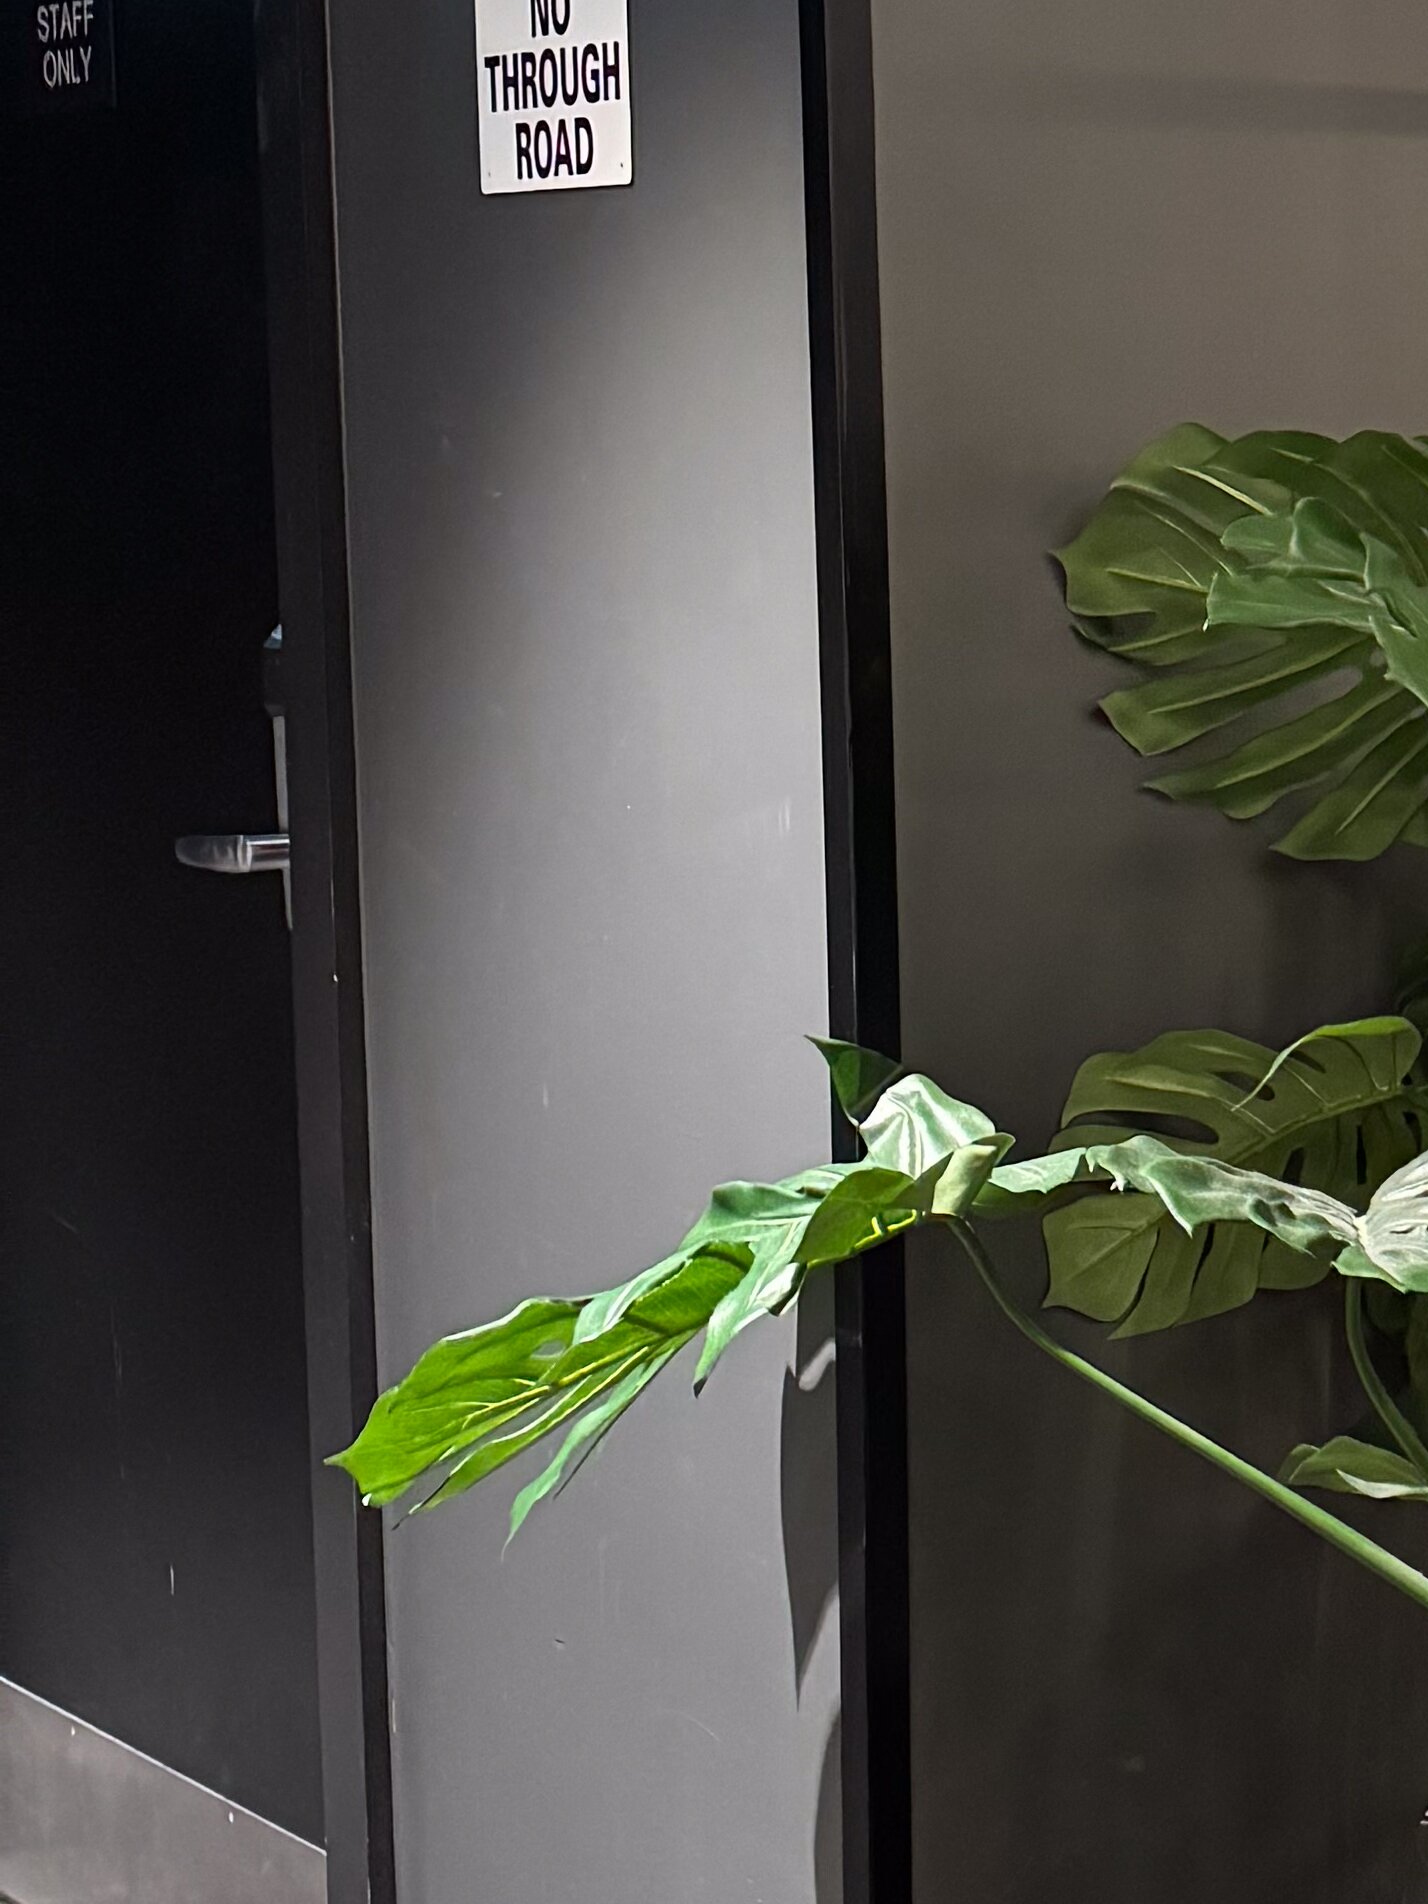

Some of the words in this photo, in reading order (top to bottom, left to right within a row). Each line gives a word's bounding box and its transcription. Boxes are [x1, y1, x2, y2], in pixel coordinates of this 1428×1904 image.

[42, 47, 92, 88] ONLY
[484, 42, 621, 113] THROUGH
[515, 117, 593, 179] ROAD
